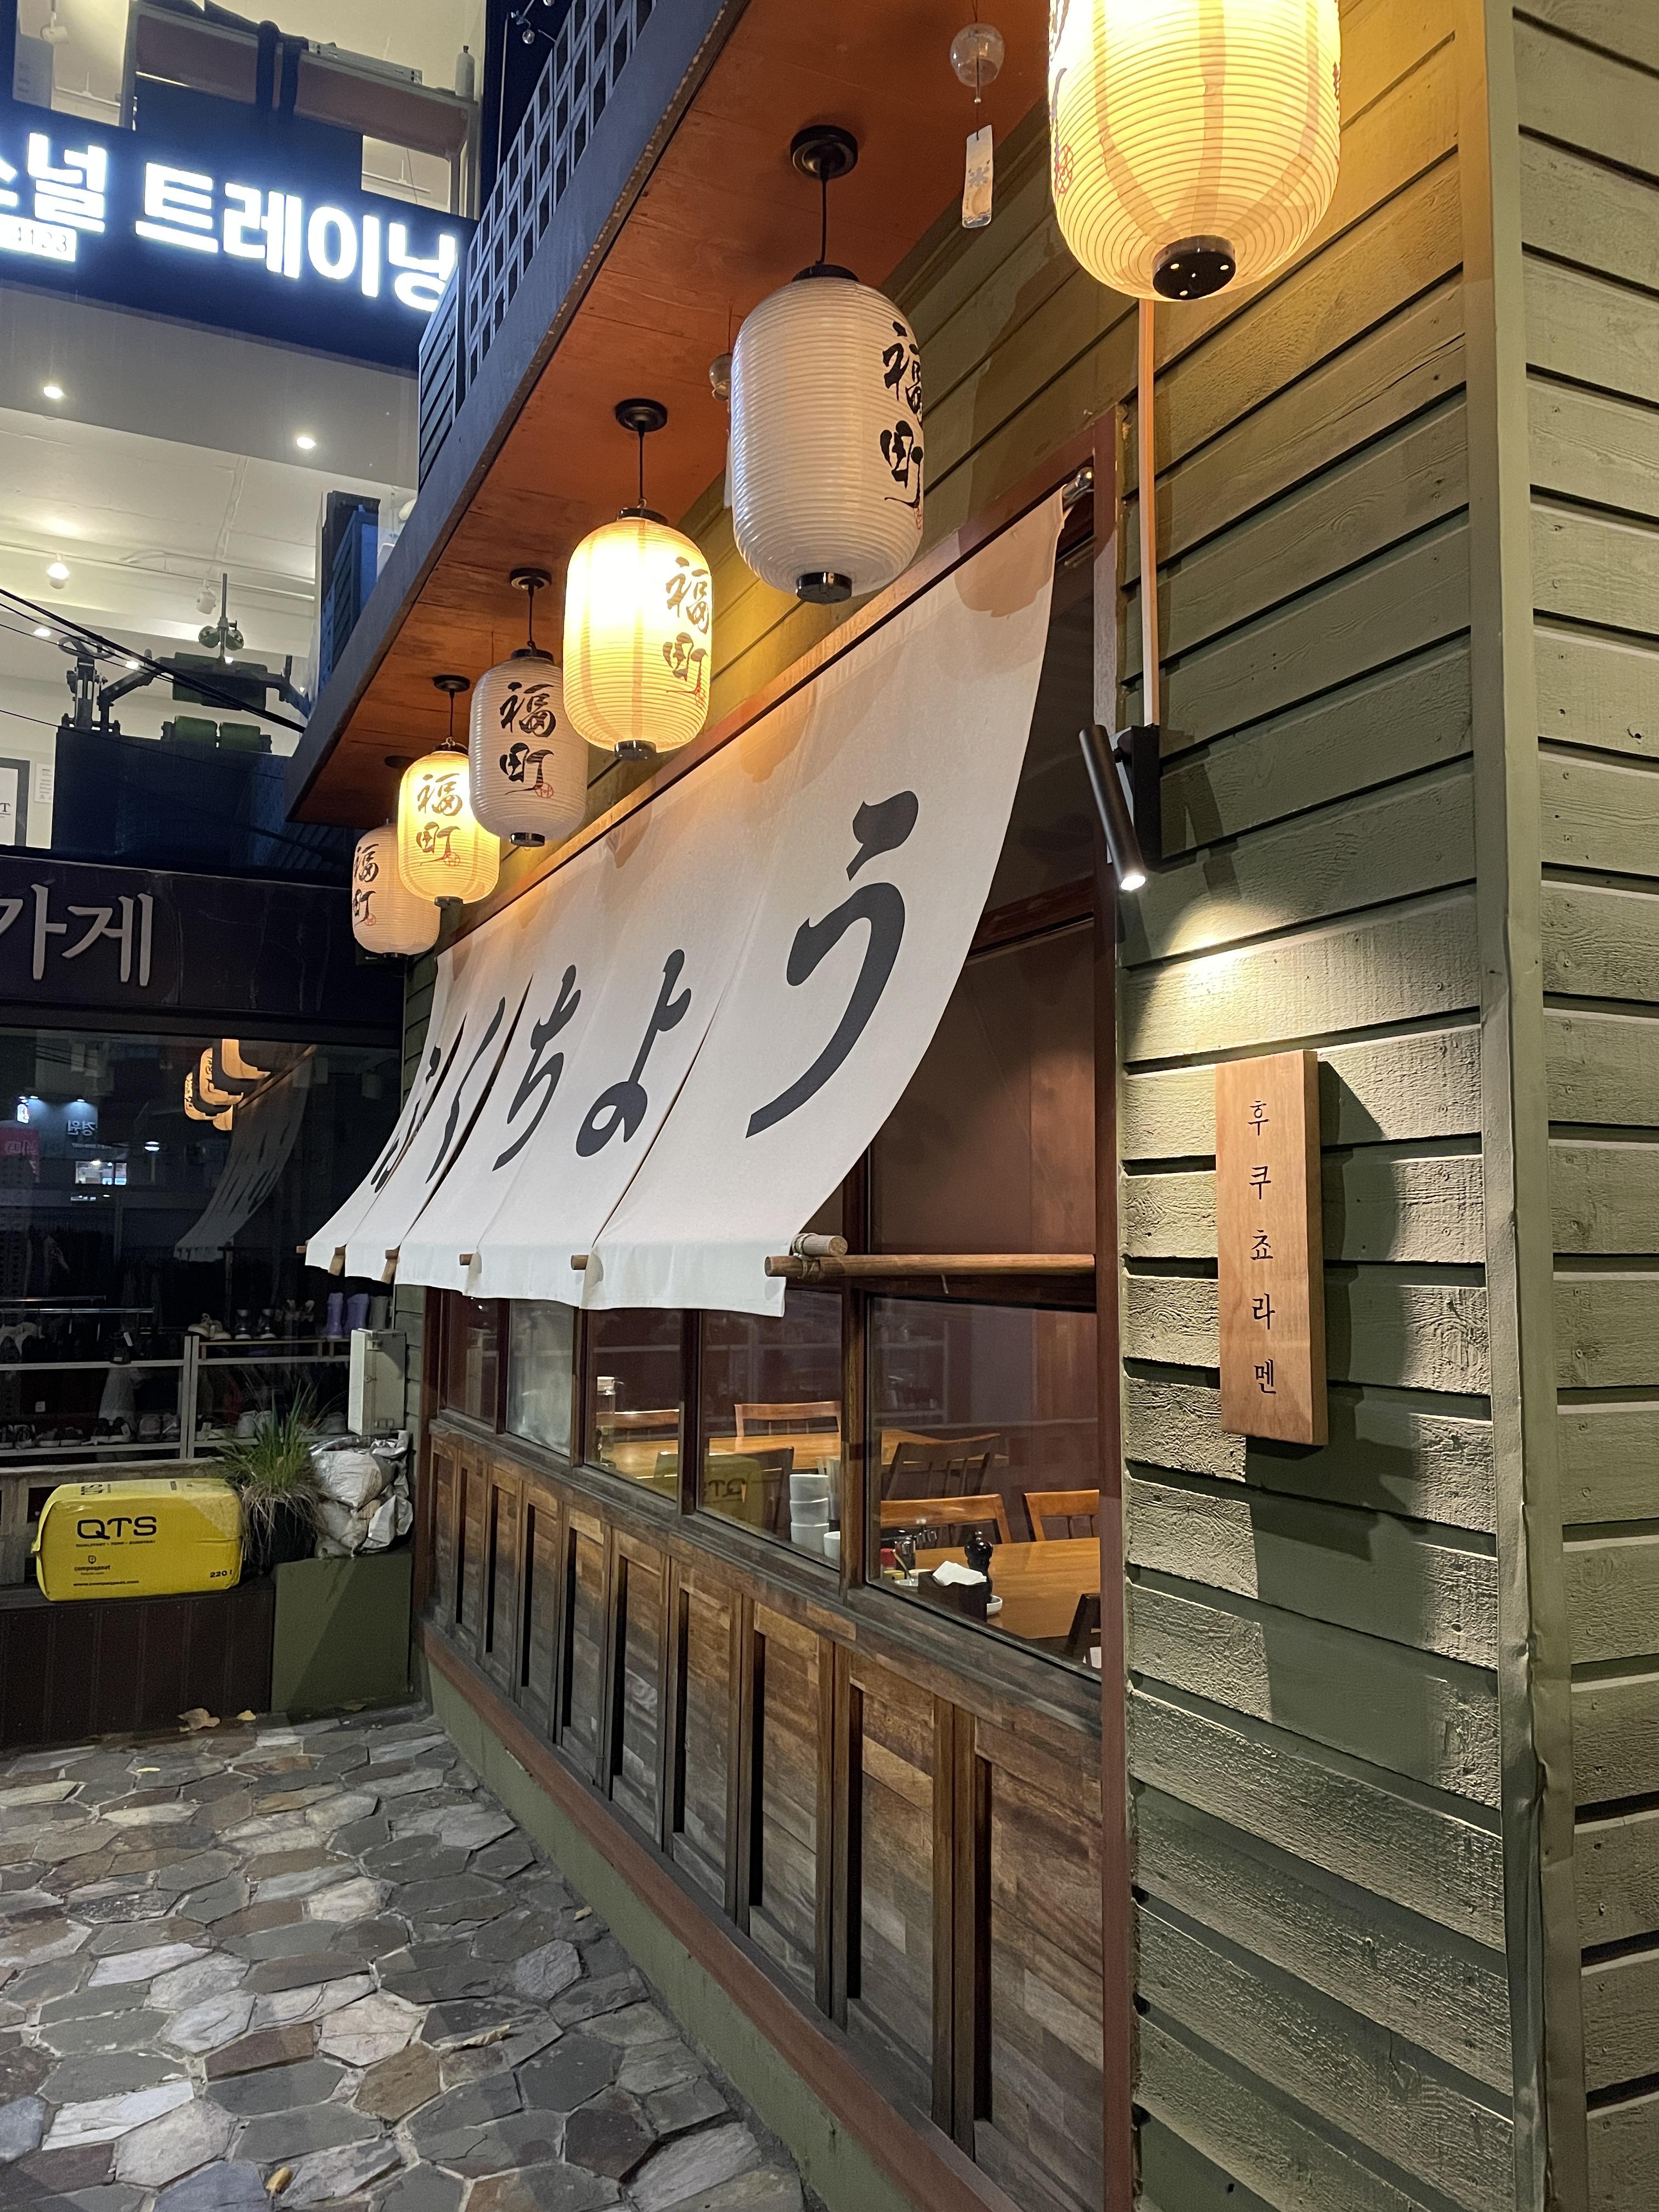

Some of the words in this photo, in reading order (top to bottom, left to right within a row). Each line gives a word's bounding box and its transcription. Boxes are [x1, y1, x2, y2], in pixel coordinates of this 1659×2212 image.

[0, 132, 106, 234] 널
[135, 162, 459, 313] 트레이닝
[499, 681, 556, 795] 福町
[0, 883, 154, 987] 가게
[1247, 1100, 1277, 1395] 후쿠쵸라멘
[77, 1516, 157, 1540] QTS
